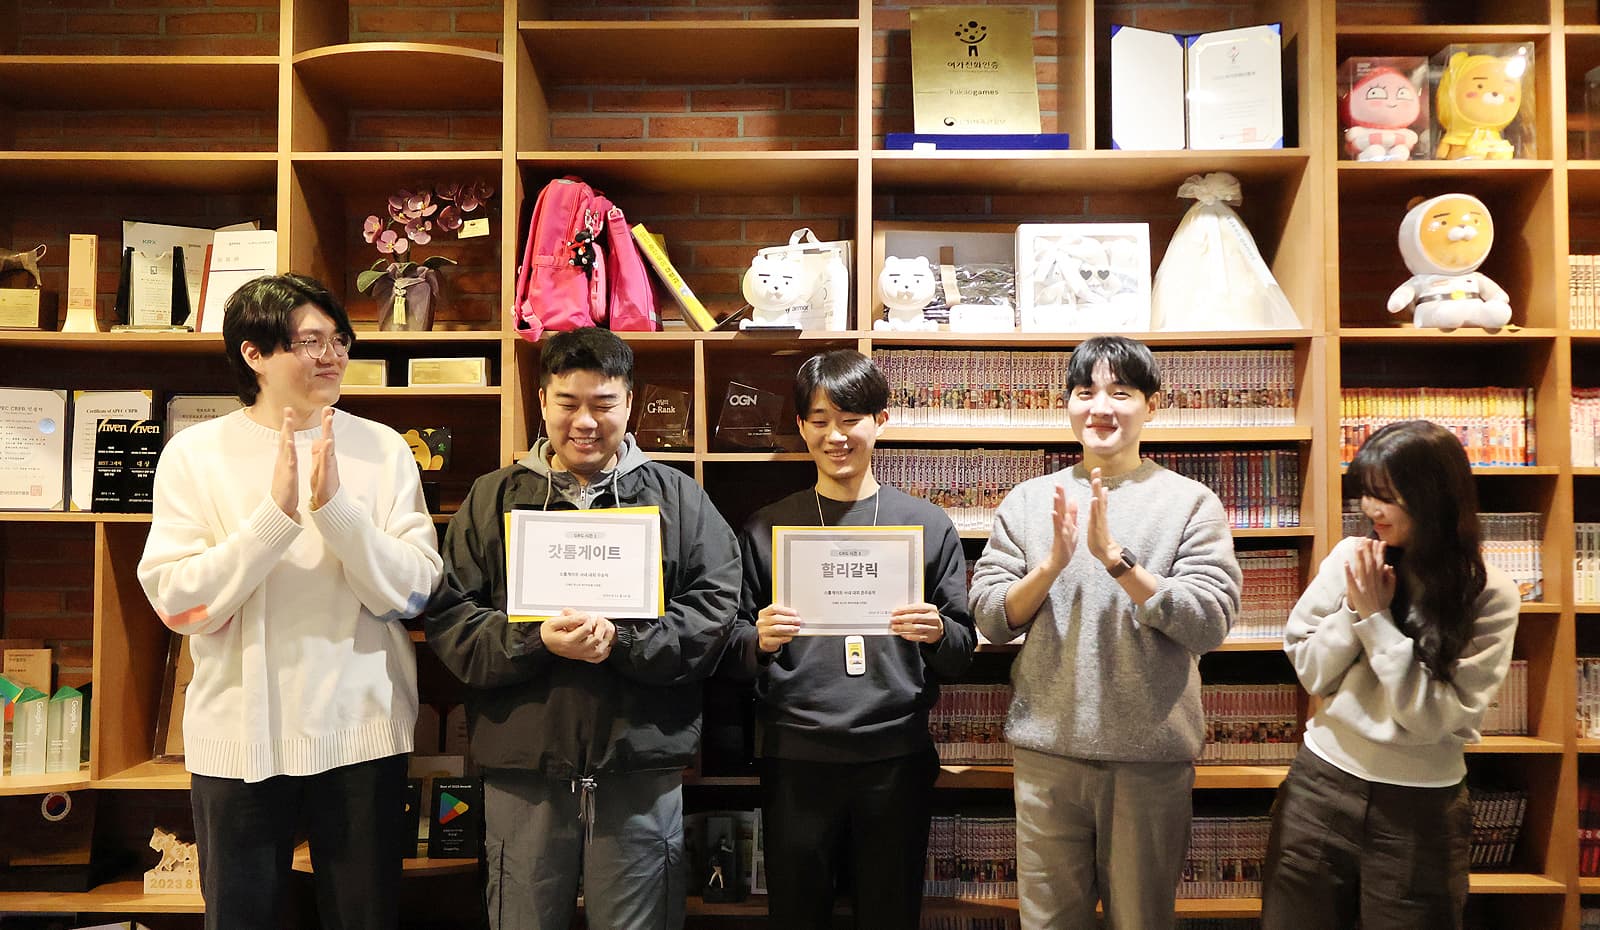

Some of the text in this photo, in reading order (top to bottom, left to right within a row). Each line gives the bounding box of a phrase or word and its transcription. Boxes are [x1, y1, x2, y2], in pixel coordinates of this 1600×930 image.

[949, 87, 999, 96] kakaogames
[729, 394, 758, 406] OGN
[548, 543, 622, 560] 갓톰게이트
[821, 562, 878, 578] 할리갈릭
[150, 878, 182, 888] 2023
[186, 879, 193, 888] 8
